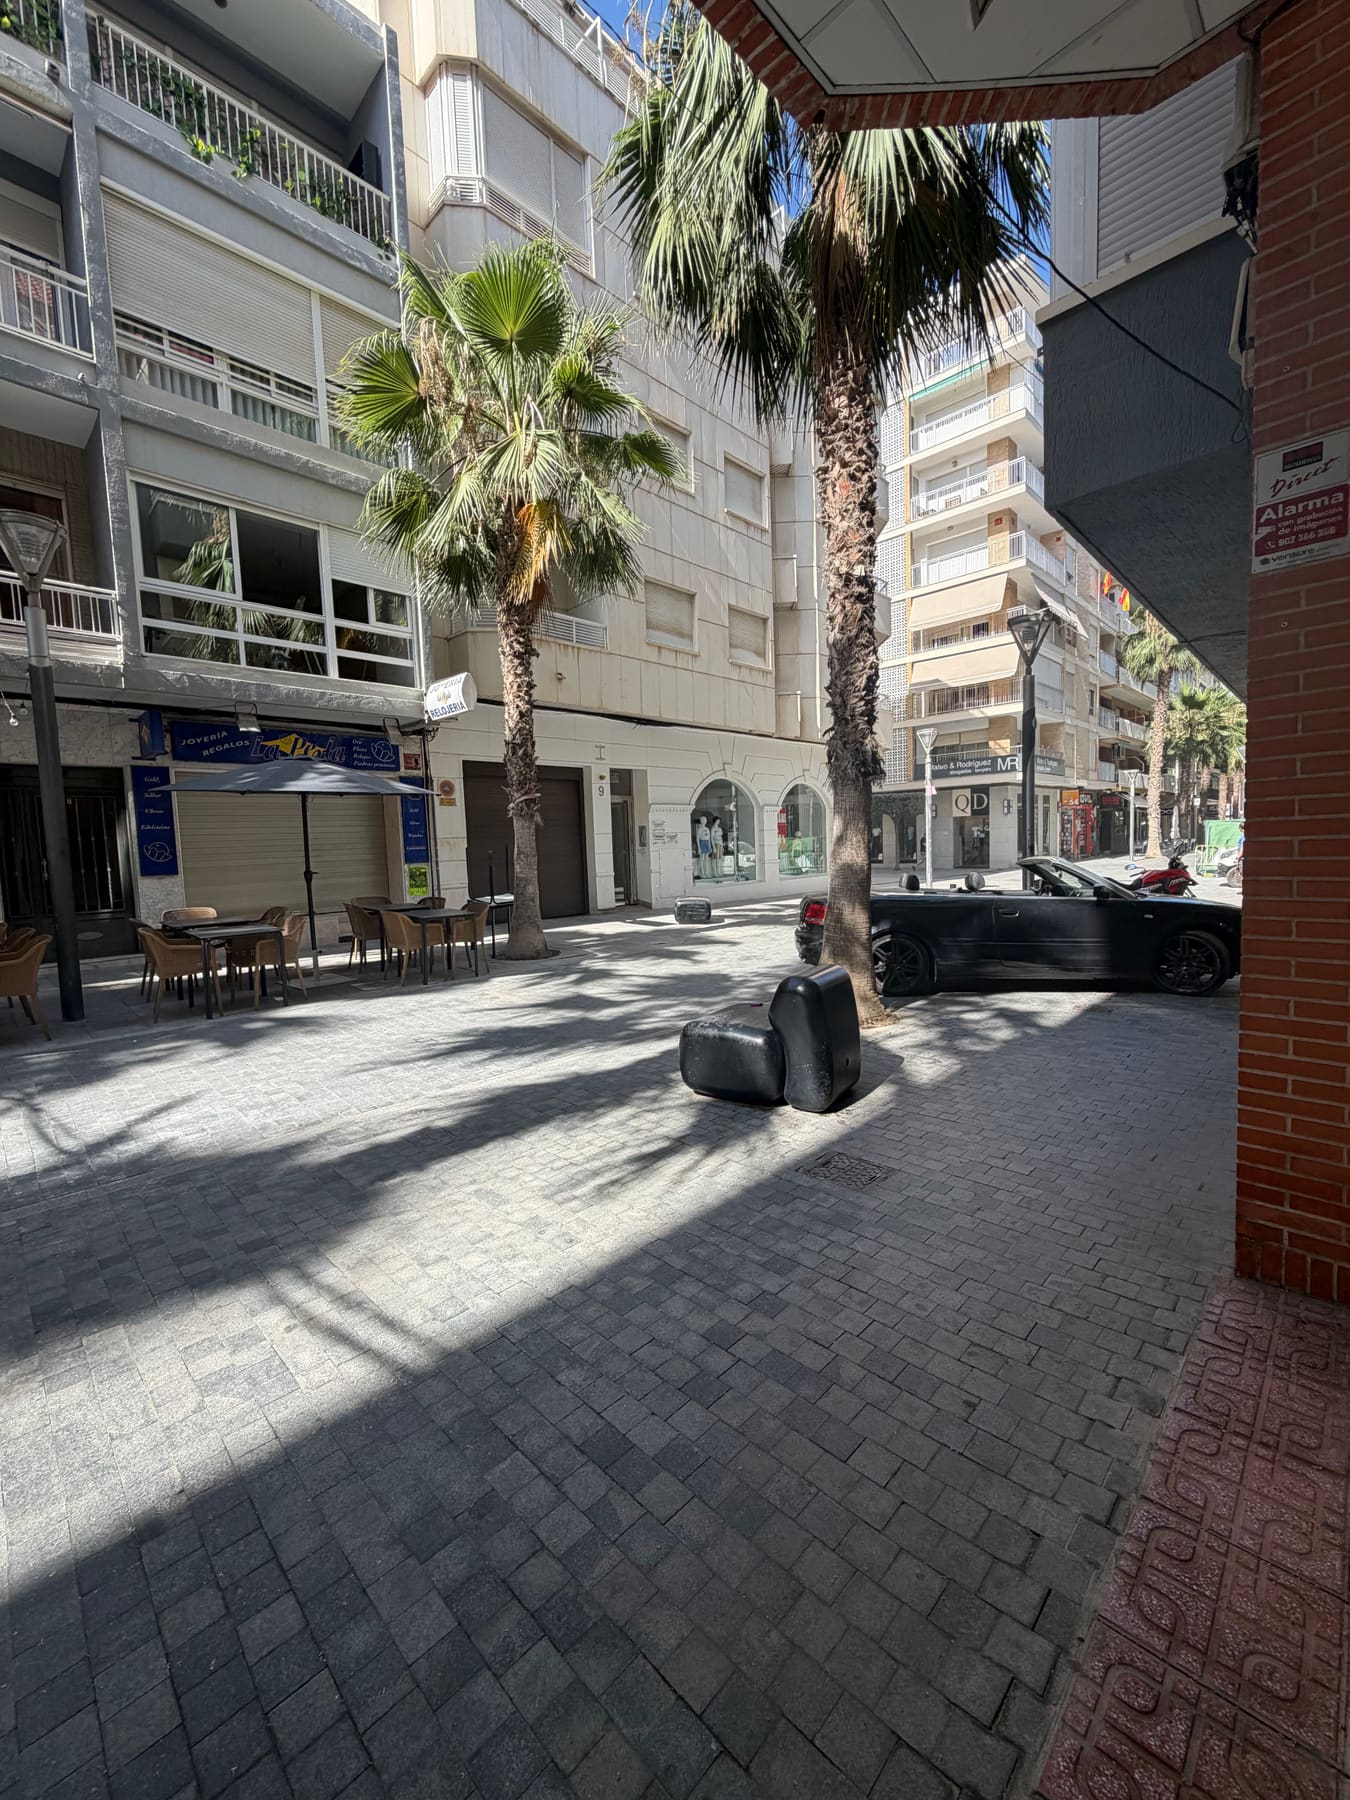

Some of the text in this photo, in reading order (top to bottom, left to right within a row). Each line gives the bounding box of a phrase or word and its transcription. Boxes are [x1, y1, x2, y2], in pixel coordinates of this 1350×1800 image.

[1270, 456, 1341, 498] Direct
[1259, 492, 1344, 523] Alarma
[1278, 520, 1295, 528] con
[1278, 527, 1291, 535] de
[430, 700, 466, 719] RELOJERIA
[181, 730, 228, 746] JOYERÍA
[202, 739, 250, 757] REGALOS
[251, 735, 280, 761] La
[997, 756, 1018, 771] MR
[598, 785, 605, 797] 9
